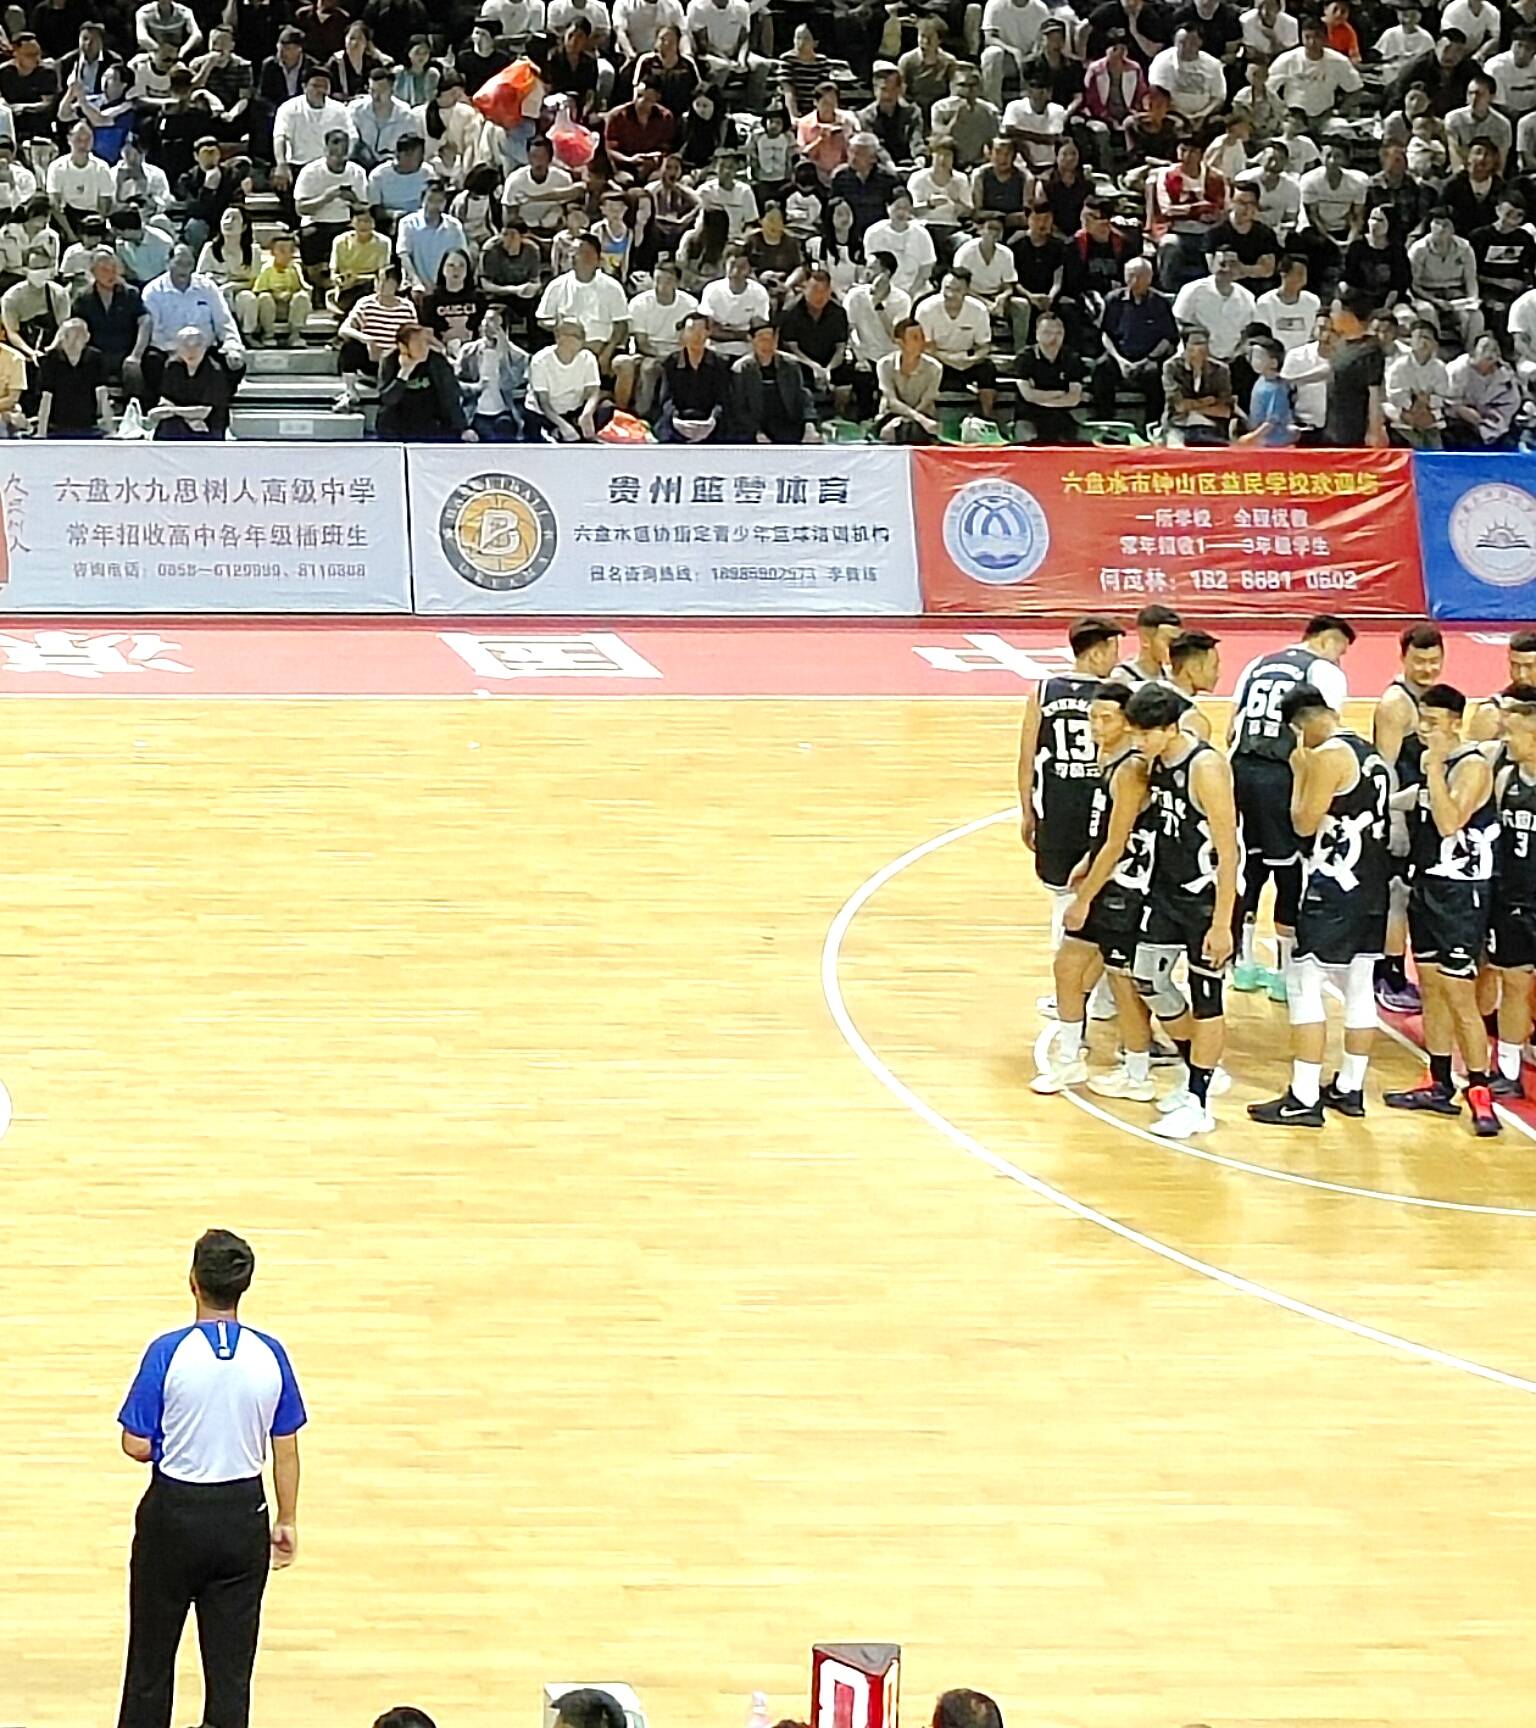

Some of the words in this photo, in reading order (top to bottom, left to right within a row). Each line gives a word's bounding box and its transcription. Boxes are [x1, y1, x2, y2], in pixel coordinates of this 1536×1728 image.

[54, 476, 376, 505] 六盘水九思树人高级中学
[66, 522, 369, 548] 常年招收高中各年级插班生
